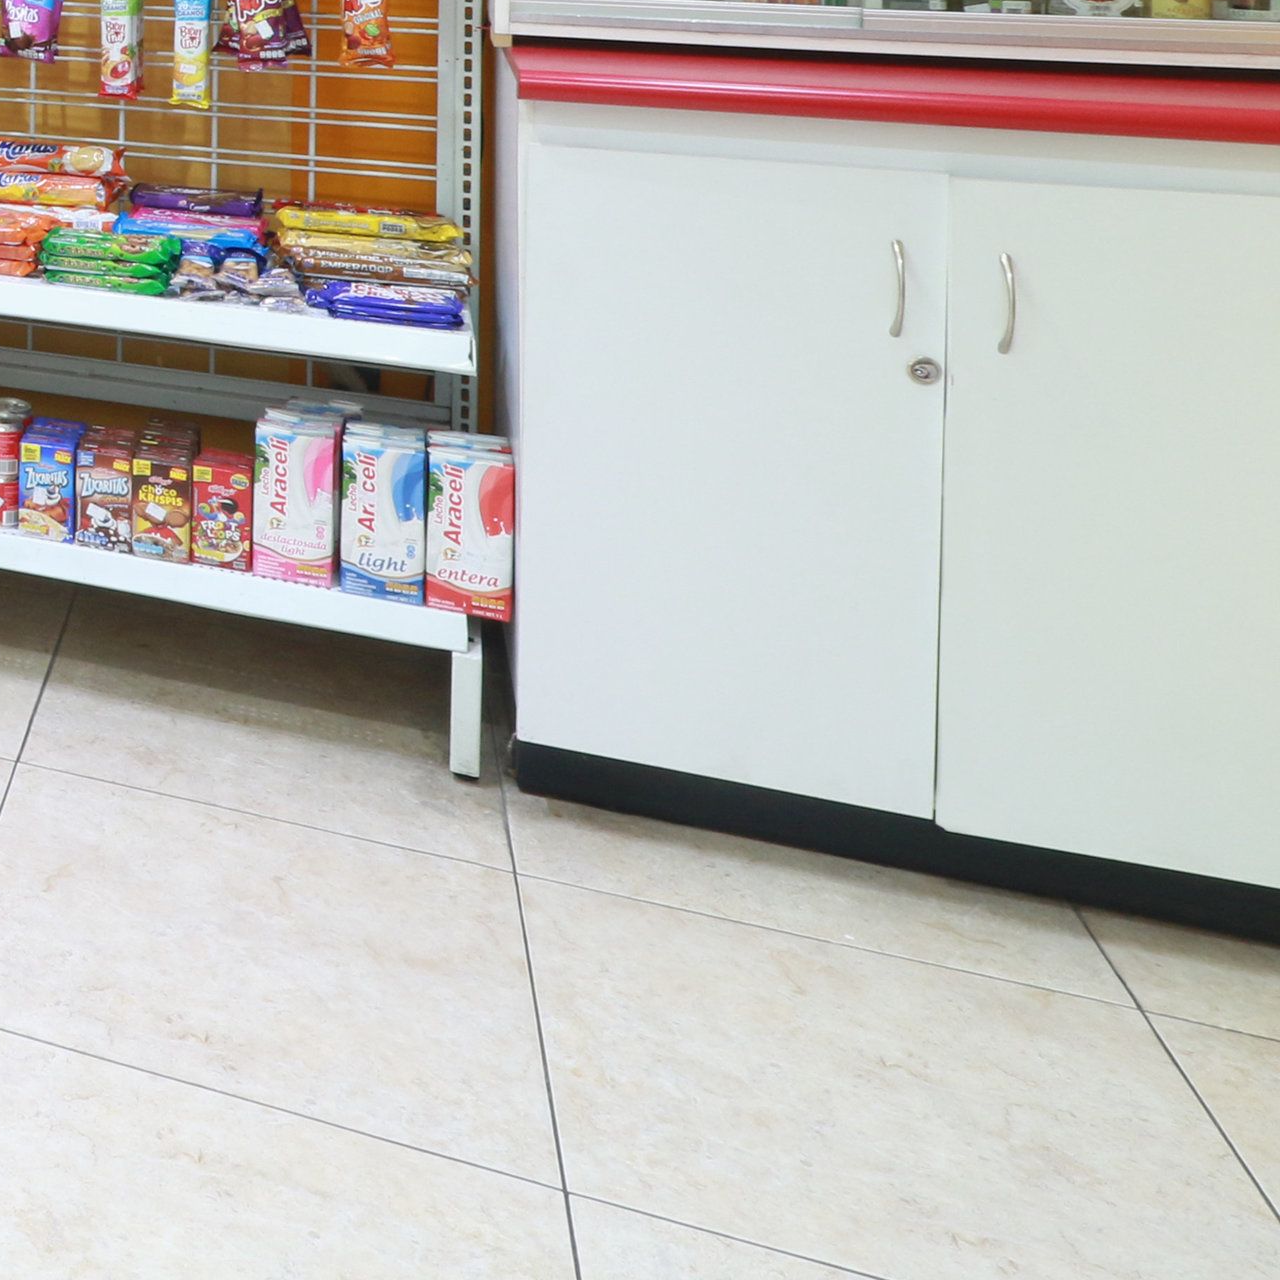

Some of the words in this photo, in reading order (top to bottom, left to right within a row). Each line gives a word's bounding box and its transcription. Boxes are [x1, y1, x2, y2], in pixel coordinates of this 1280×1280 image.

[5, 0, 40, 24] Pasitas
[25, 468, 69, 489] ZUCARITAS
[80, 472, 130, 498] ZUCARITAS
[260, 468, 271, 496] Leche
[269, 436, 290, 517] Araceli
[138, 490, 184, 508] KRISPIS
[142, 484, 178, 498] CHOCO
[356, 450, 378, 533] Arceli
[443, 463, 465, 546] Araceli
[259, 532, 328, 551] deslactosada
[280, 545, 306, 557] light
[357, 553, 408, 573] light
[436, 566, 500, 589] entera
